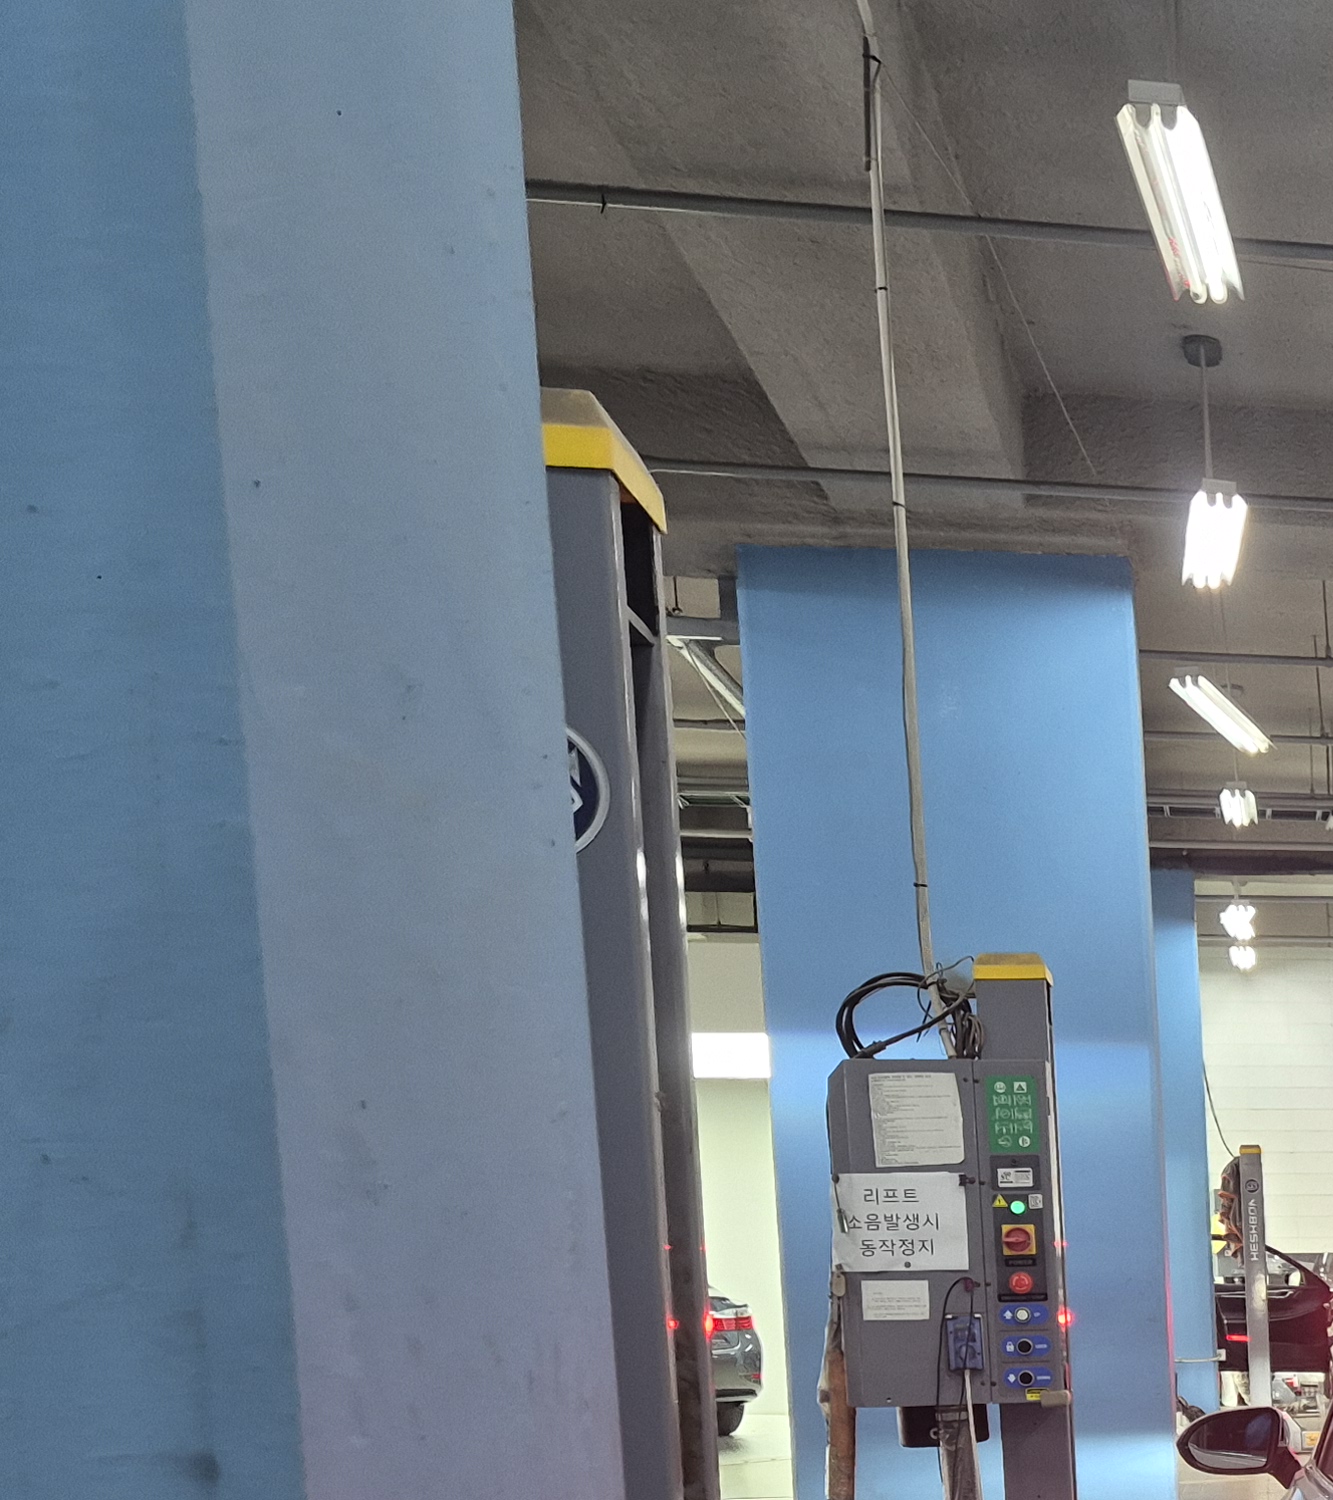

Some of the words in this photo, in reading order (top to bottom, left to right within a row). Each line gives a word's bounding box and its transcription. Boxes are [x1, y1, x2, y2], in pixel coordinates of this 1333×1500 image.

[863, 1188, 919, 1205] 리프트
[848, 1212, 940, 1231] 소음발생시
[859, 1238, 935, 1257] 동작정지
